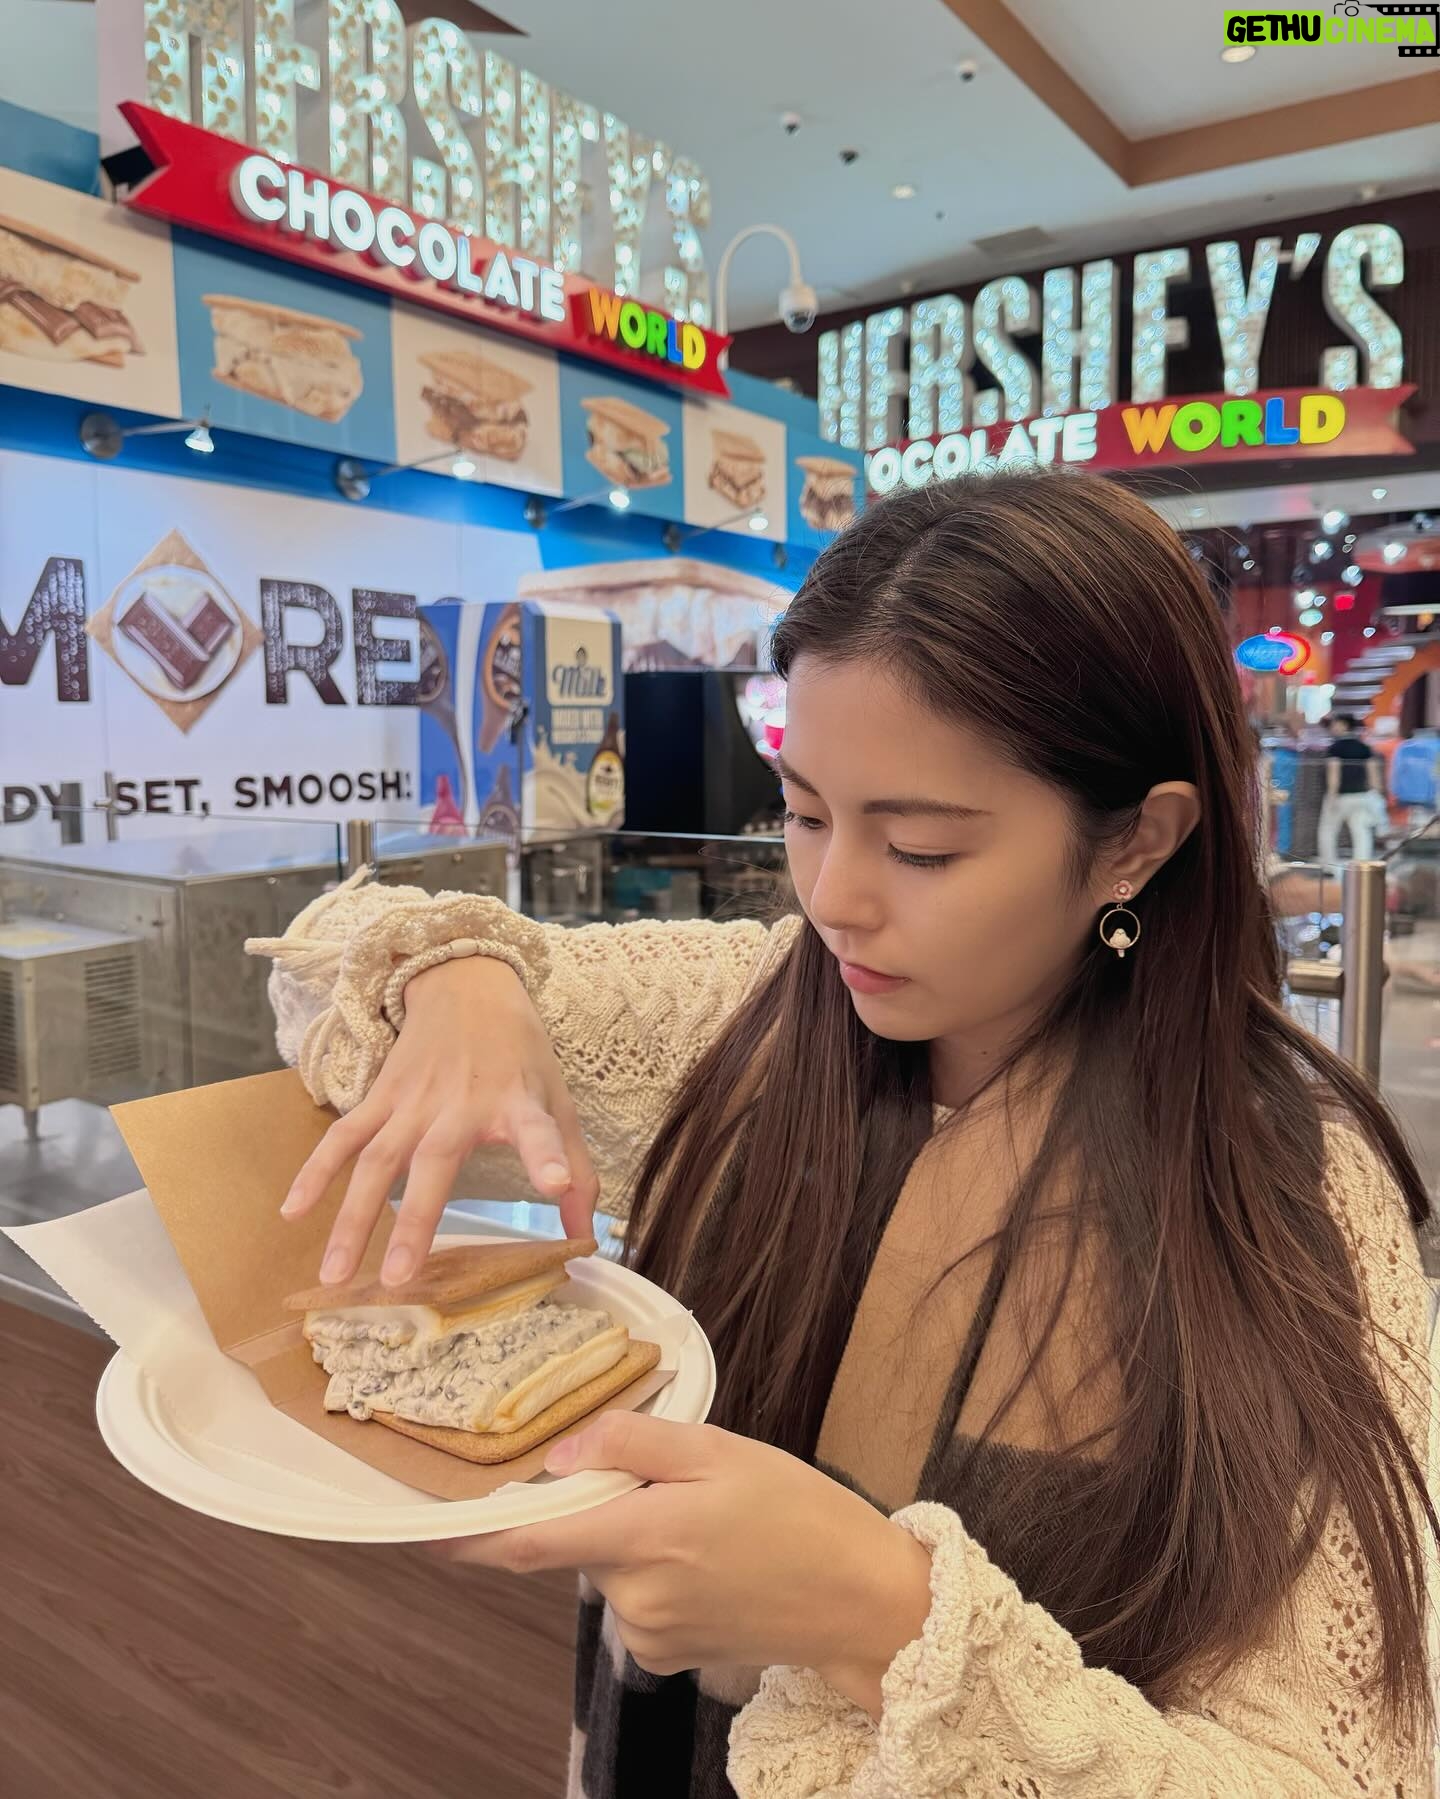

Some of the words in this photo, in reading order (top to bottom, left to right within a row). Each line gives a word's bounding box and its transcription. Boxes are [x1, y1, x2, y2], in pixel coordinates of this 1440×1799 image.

[239, 155, 565, 322] CHOCOLATE
[588, 287, 706, 370] WORLD
[818, 223, 1404, 450] HERSHEY'S
[1121, 394, 1345, 454] WORLD
[112, 779, 210, 819] SET,
[234, 769, 412, 809] SMOOSH!
